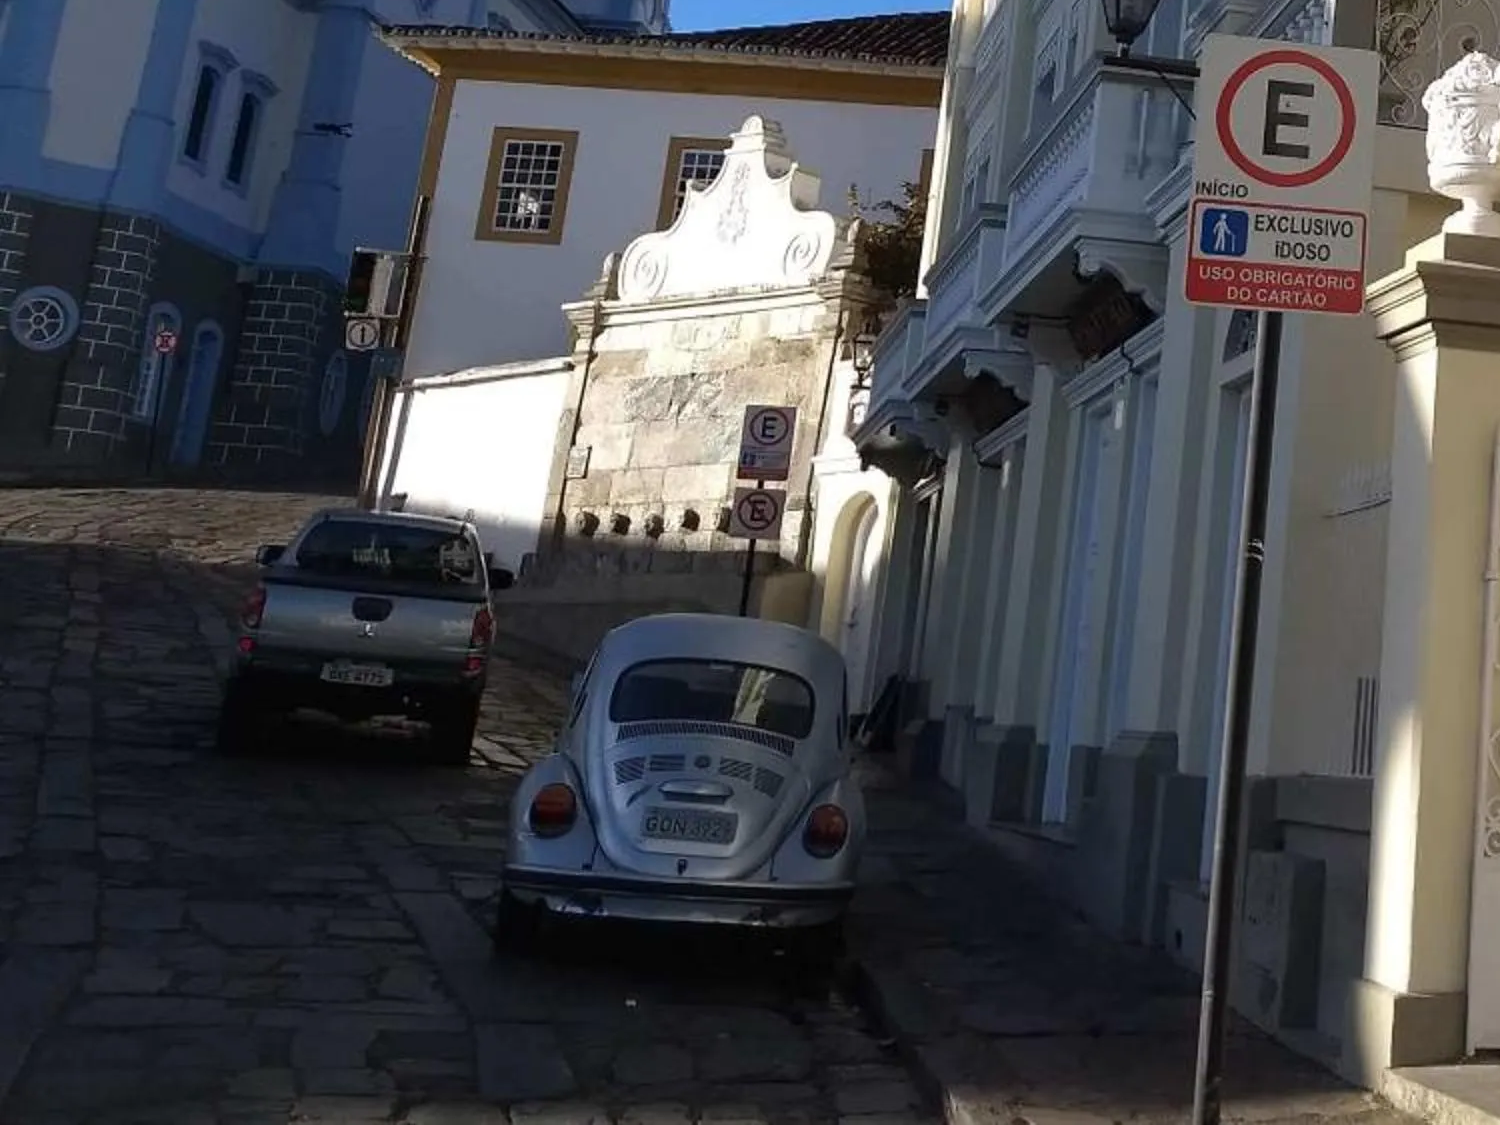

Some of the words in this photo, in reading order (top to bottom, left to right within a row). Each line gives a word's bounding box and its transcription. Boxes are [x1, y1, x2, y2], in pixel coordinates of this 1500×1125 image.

[1262, 79, 1315, 160] E
[1195, 179, 1249, 198] INÍCIO
[1254, 214, 1354, 238] EXCLUSIVO
[1199, 264, 1235, 281] USO
[1227, 286, 1251, 302] DO
[761, 415, 777, 439] E
